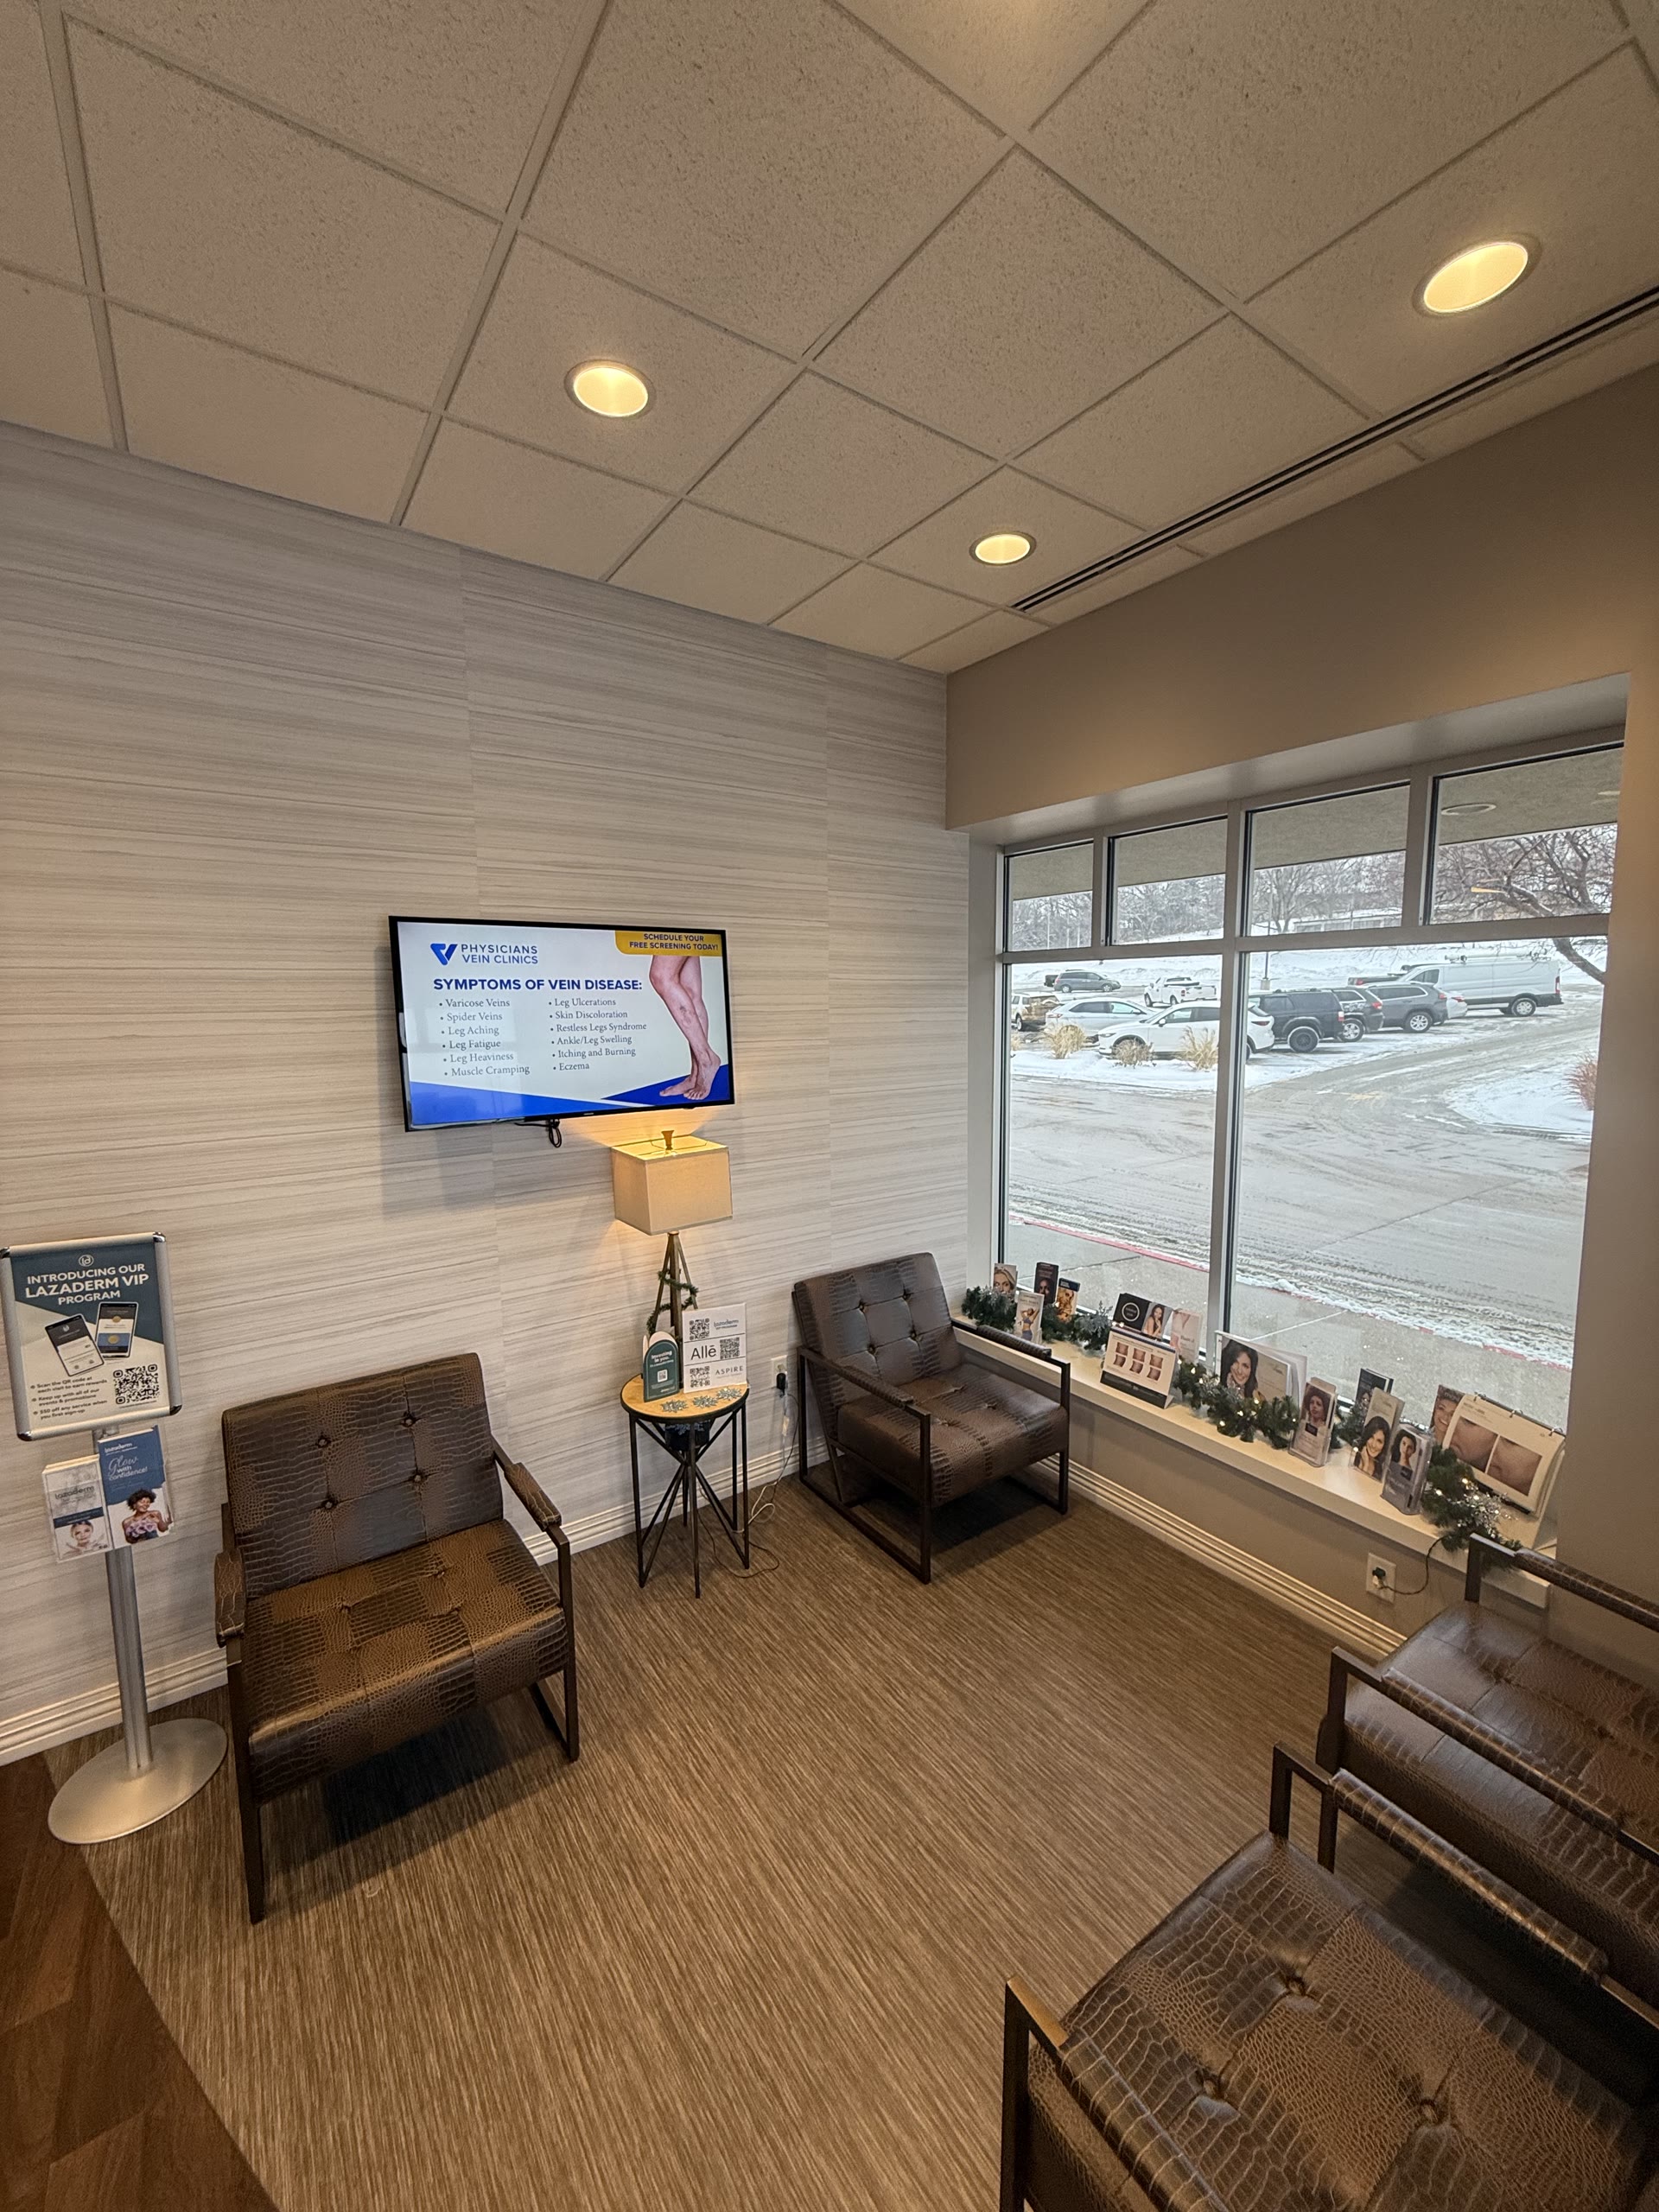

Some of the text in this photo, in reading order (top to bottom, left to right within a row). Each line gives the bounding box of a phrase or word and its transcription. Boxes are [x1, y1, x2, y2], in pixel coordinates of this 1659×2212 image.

[461, 944, 537, 955] PHYSICIANS
[462, 954, 538, 964] VEIN CLINICS
[433, 978, 642, 990] SYMPTOMS OF VEIN DISEASE:
[445, 998, 511, 1007] Varicose Veins
[554, 997, 616, 1008] Leg Ulcerations
[447, 1012, 503, 1023] Spider Veins
[555, 1010, 628, 1019] Skin Discoloration
[448, 1026, 499, 1037] Leg Aching
[556, 1021, 647, 1033] Restless Legs Syndrome
[449, 1039, 501, 1051] Leg Fatigue
[556, 1035, 632, 1046] Ankle/Leg Swelling
[557, 1047, 637, 1059] Itching and Burning
[450, 1053, 514, 1065] Leg Heaviness
[451, 1065, 531, 1076] Muscle Cramping
[559, 1062, 590, 1071] Eczema
[28, 1263, 145, 1284] INTRODUCING OUR
[25, 1274, 149, 1298] LAZADERM VIP
[58, 1290, 121, 1305] PROGRAM
[690, 1344, 716, 1360] Allē
[715, 1365, 743, 1376] ASPIRE
